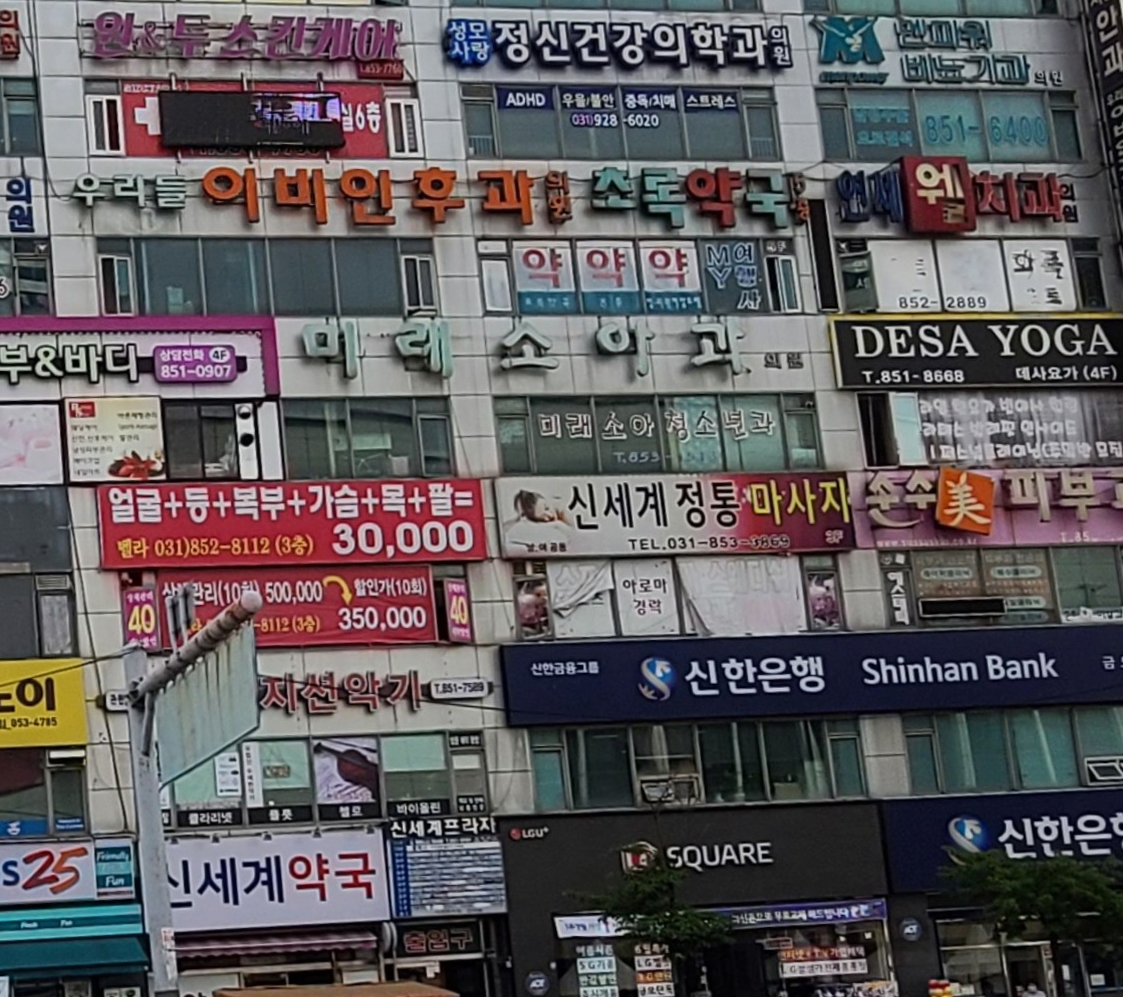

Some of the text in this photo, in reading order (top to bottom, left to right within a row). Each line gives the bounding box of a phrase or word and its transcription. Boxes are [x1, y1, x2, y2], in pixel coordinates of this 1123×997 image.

[448, 20, 488, 42] 성모
[494, 20, 791, 68] 정신건강의학과 의원
[505, 92, 547, 107] ADHD
[685, 93, 737, 109] 스트레스
[925, 115, 1049, 148] 851-6400
[73, 172, 188, 210] 우리들
[202, 166, 534, 226] 이비인후과
[590, 166, 789, 230] 초록약국
[974, 170, 1065, 224] 치과
[522, 248, 563, 288] 약
[586, 248, 627, 288] 약
[648, 247, 689, 288] 약
[897, 295, 988, 310] 852-2889
[160, 348, 228, 362] 상담전화 4F
[302, 316, 751, 379] 미래 소아과
[851, 323, 1118, 359] DESA YOGA
[160, 363, 232, 379] 851-0907
[861, 365, 1118, 385] T.851-8668 데사요가 (4F)
[538, 408, 776, 442] 미래 소아 청소년과
[567, 477, 852, 531] 신세계 정통 마사지
[942, 471, 992, 527] 美
[154, 534, 314, 558] 031)852-8112 (3층)
[331, 520, 474, 558] 30,000
[265, 580, 323, 604] 500,000
[622, 578, 667, 594] 아로마
[128, 604, 156, 635] 40
[337, 606, 427, 630] 350,000
[449, 596, 469, 624] 40
[633, 598, 662, 615] 경락
[530, 661, 599, 677] 신한금융그룹
[685, 652, 1060, 696] 신한은행 Shinhan Bank
[395, 801, 442, 816] 바이올린
[390, 817, 497, 839] 신세계프라자
[666, 841, 774, 873] SQUARE
[167, 852, 377, 908] 신세계약국
